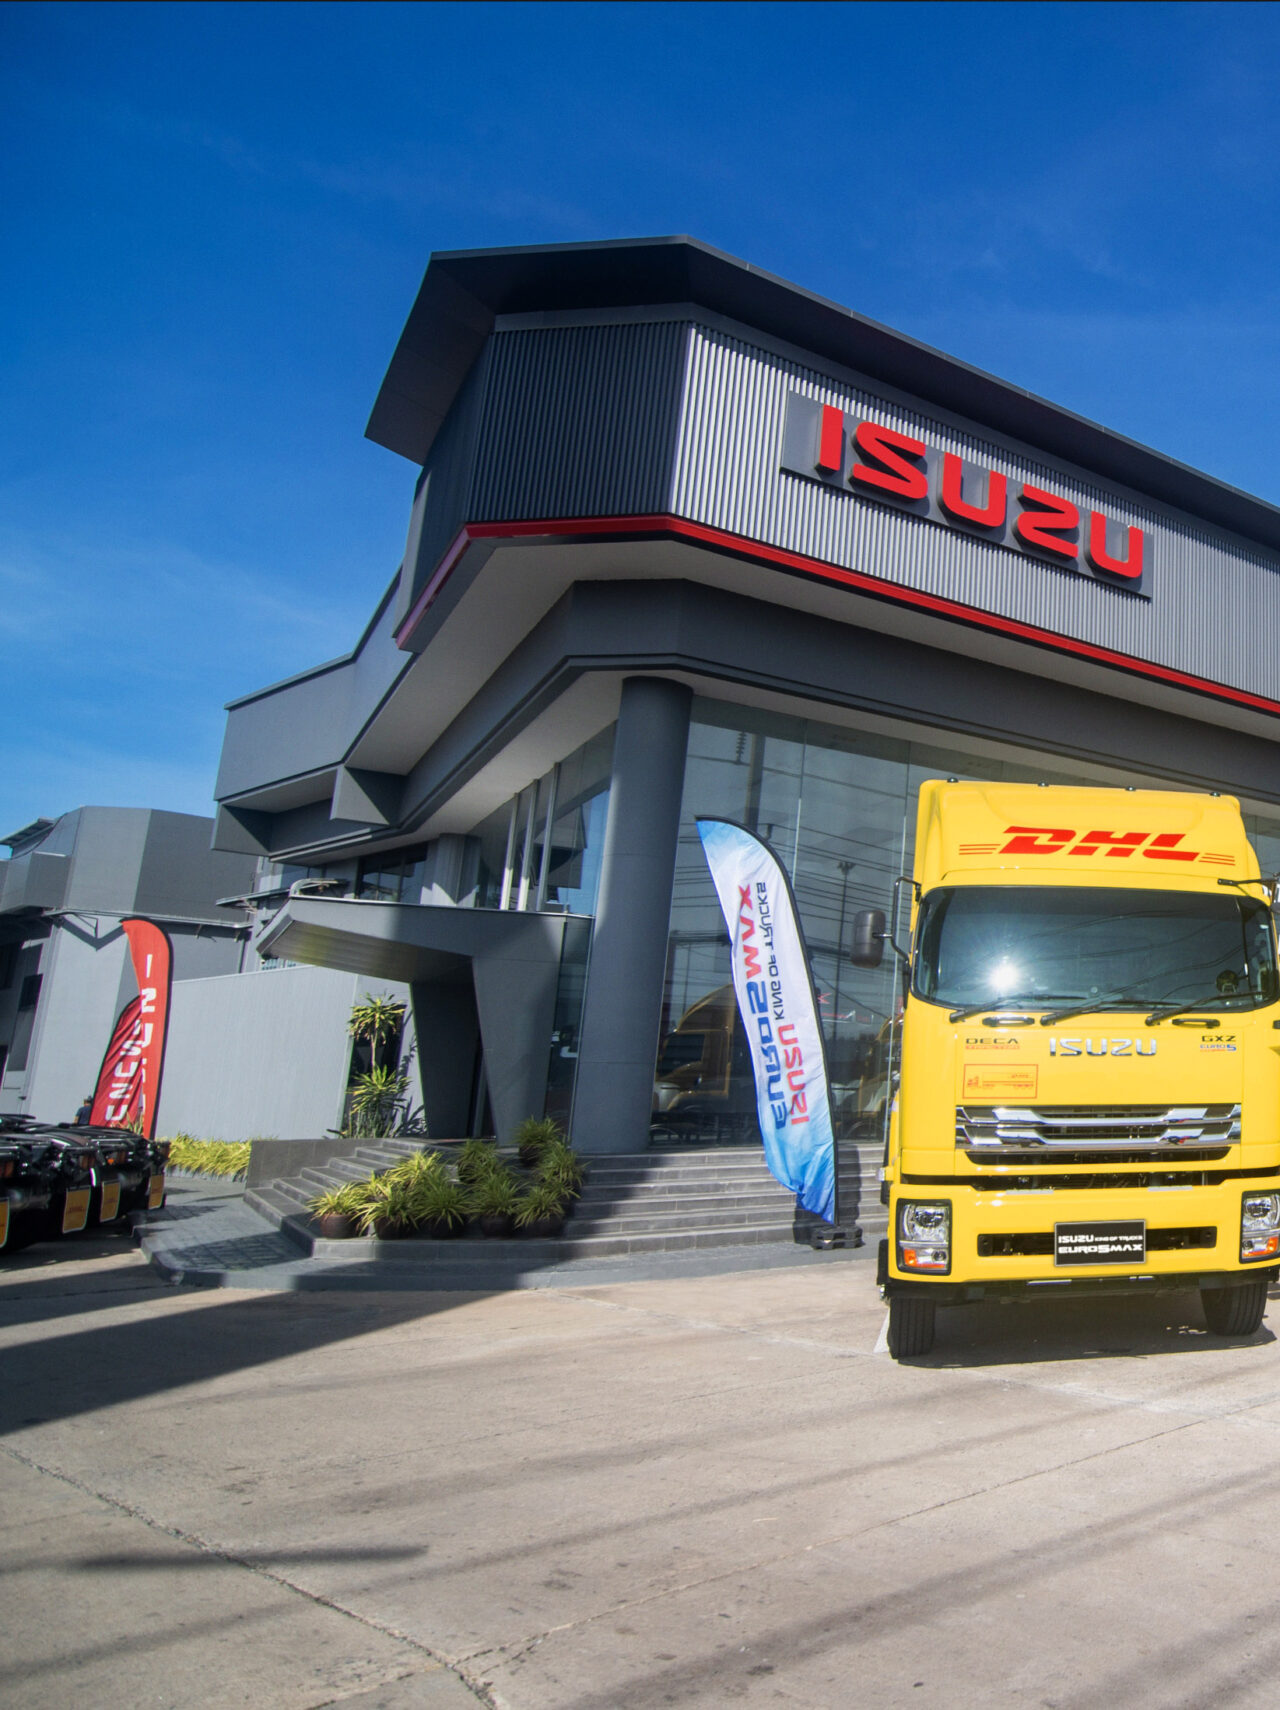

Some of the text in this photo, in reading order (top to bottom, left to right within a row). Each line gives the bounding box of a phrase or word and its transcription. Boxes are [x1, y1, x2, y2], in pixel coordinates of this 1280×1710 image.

[816, 403, 1144, 579] ISUZU
[1000, 826, 1199, 862] DHL
[1049, 1037, 1157, 1057] ISUZU
[1058, 1234, 1094, 1243] ISUZU
